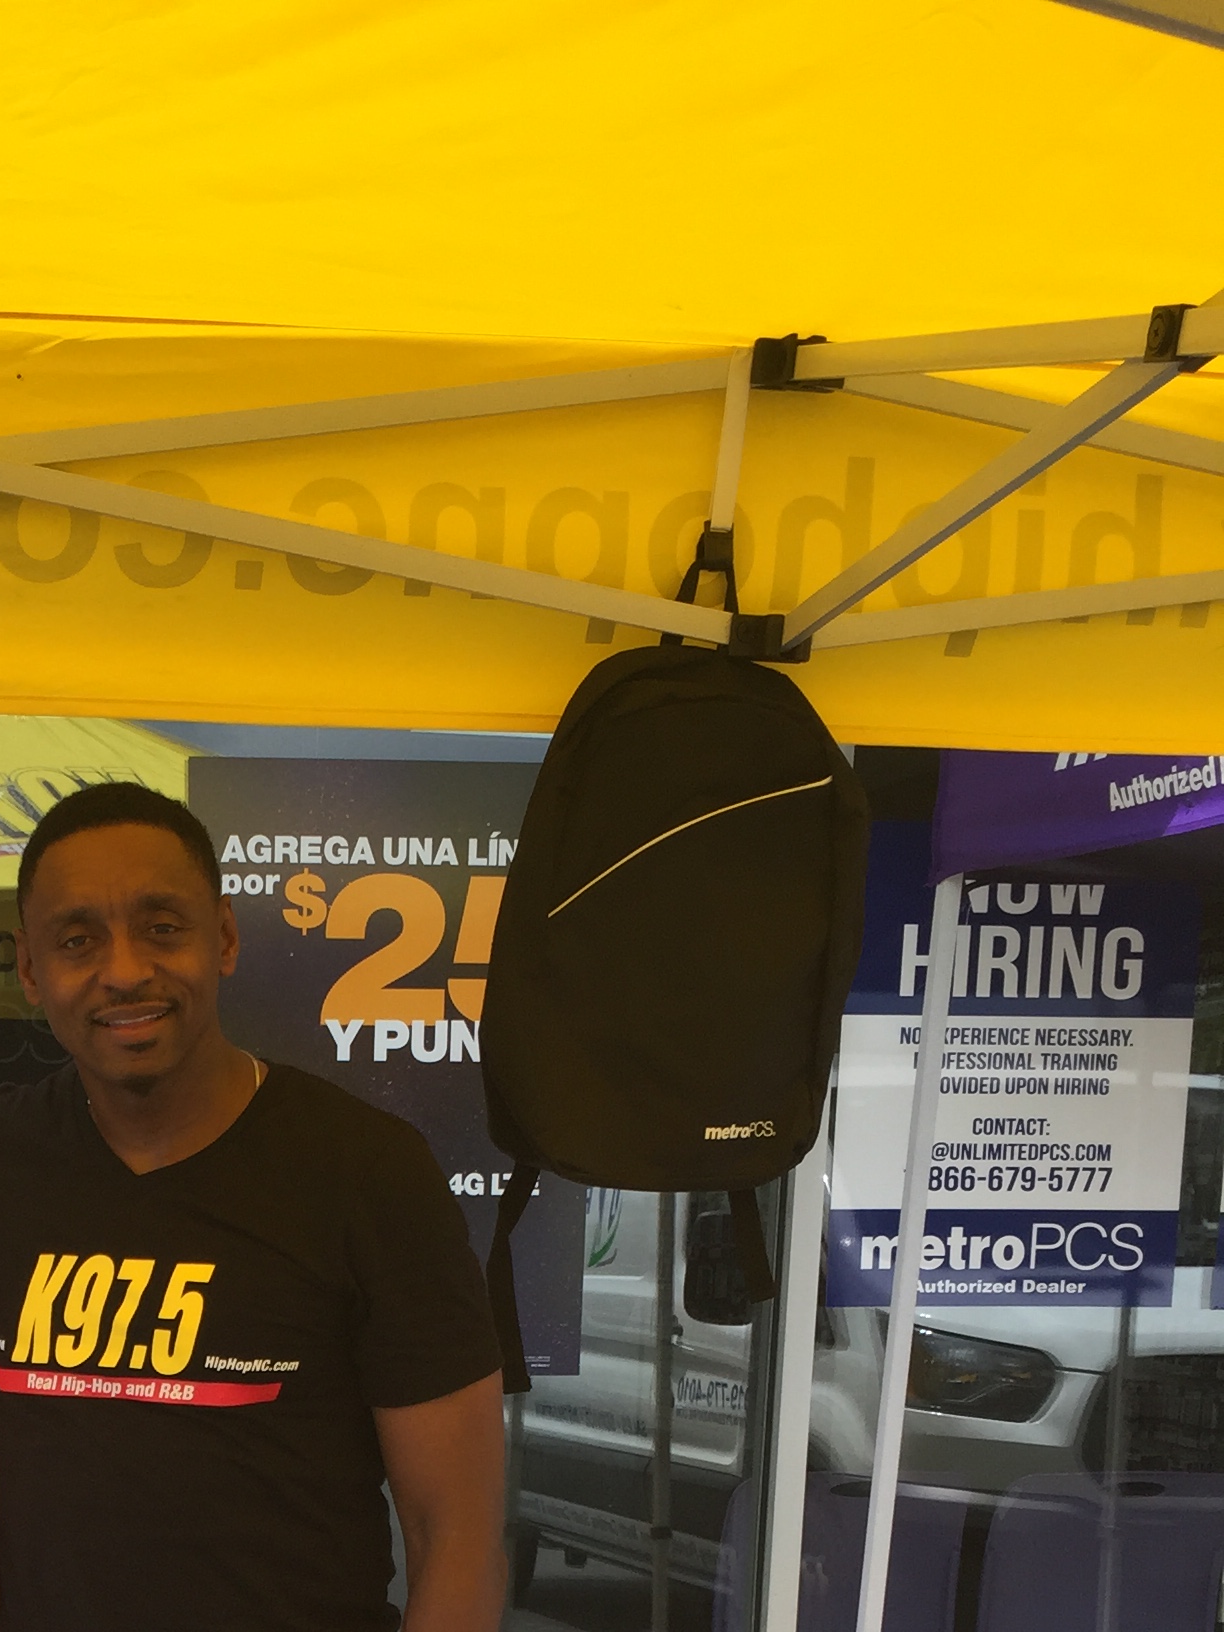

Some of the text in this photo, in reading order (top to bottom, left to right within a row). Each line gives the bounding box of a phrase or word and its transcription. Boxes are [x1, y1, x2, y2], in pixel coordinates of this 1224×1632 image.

[1109, 756, 1217, 812] Authorized
[221, 835, 376, 865] AGREGA
[383, 837, 459, 866] UNA
[222, 872, 280, 896] por
[899, 923, 1145, 1000] HIRING
[325, 1020, 365, 1062] Y
[900, 1026, 922, 1044] NO
[1035, 1028, 1134, 1047] NECESSARY.
[1041, 1053, 1118, 1071] TRAINING
[939, 1076, 1110, 1096] OVIDED UPON HIRING
[704, 1121, 775, 1140] metroPCS
[972, 1117, 1050, 1136] CONTACT:
[448, 1172, 485, 1196] 4G
[860, 1221, 1144, 1271] metroPCS
[915, 1279, 1087, 1294] Authorized Dealer
[11, 1253, 216, 1376] K97.5
[204, 1355, 300, 1373] HipHopNC.com
[27, 1373, 195, 1401] Real Hip-Hop and R&B
